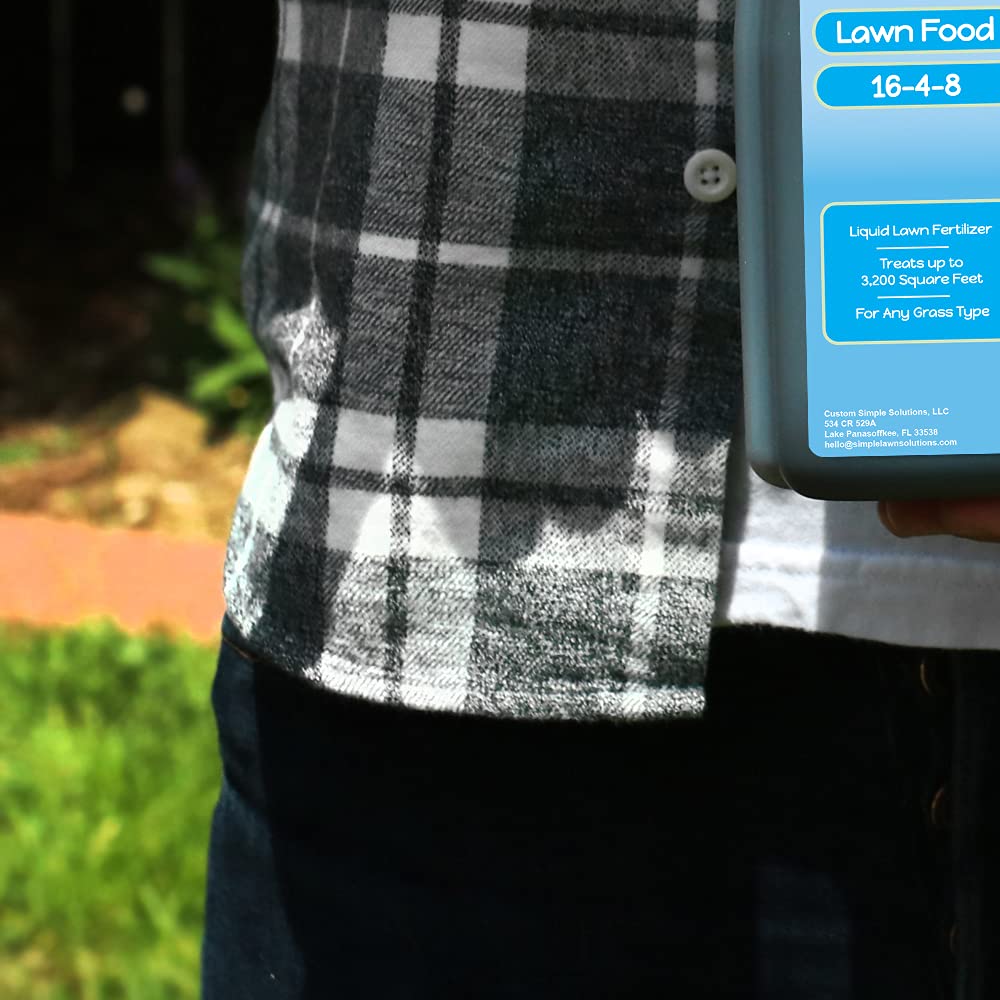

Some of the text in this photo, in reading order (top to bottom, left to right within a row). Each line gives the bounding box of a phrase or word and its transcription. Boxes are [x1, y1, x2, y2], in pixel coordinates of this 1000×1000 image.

[836, 15, 995, 44] Lawn Food
[871, 73, 962, 99] 16-4-8
[849, 223, 992, 240] Liquid Lawn Fertilizer
[880, 257, 964, 272] Treats up to
[861, 272, 983, 288] 3,200 Square Feet
[855, 305, 991, 322] For Any Grass Type
[823, 407, 950, 418] Custom Simple Solutions, LLC
[824, 419, 877, 428] 534 CR 529A
[824, 428, 939, 439] Lake Panasoffkee, FL 33538
[824, 439, 957, 450] hello@simplelawnsolutions.com
